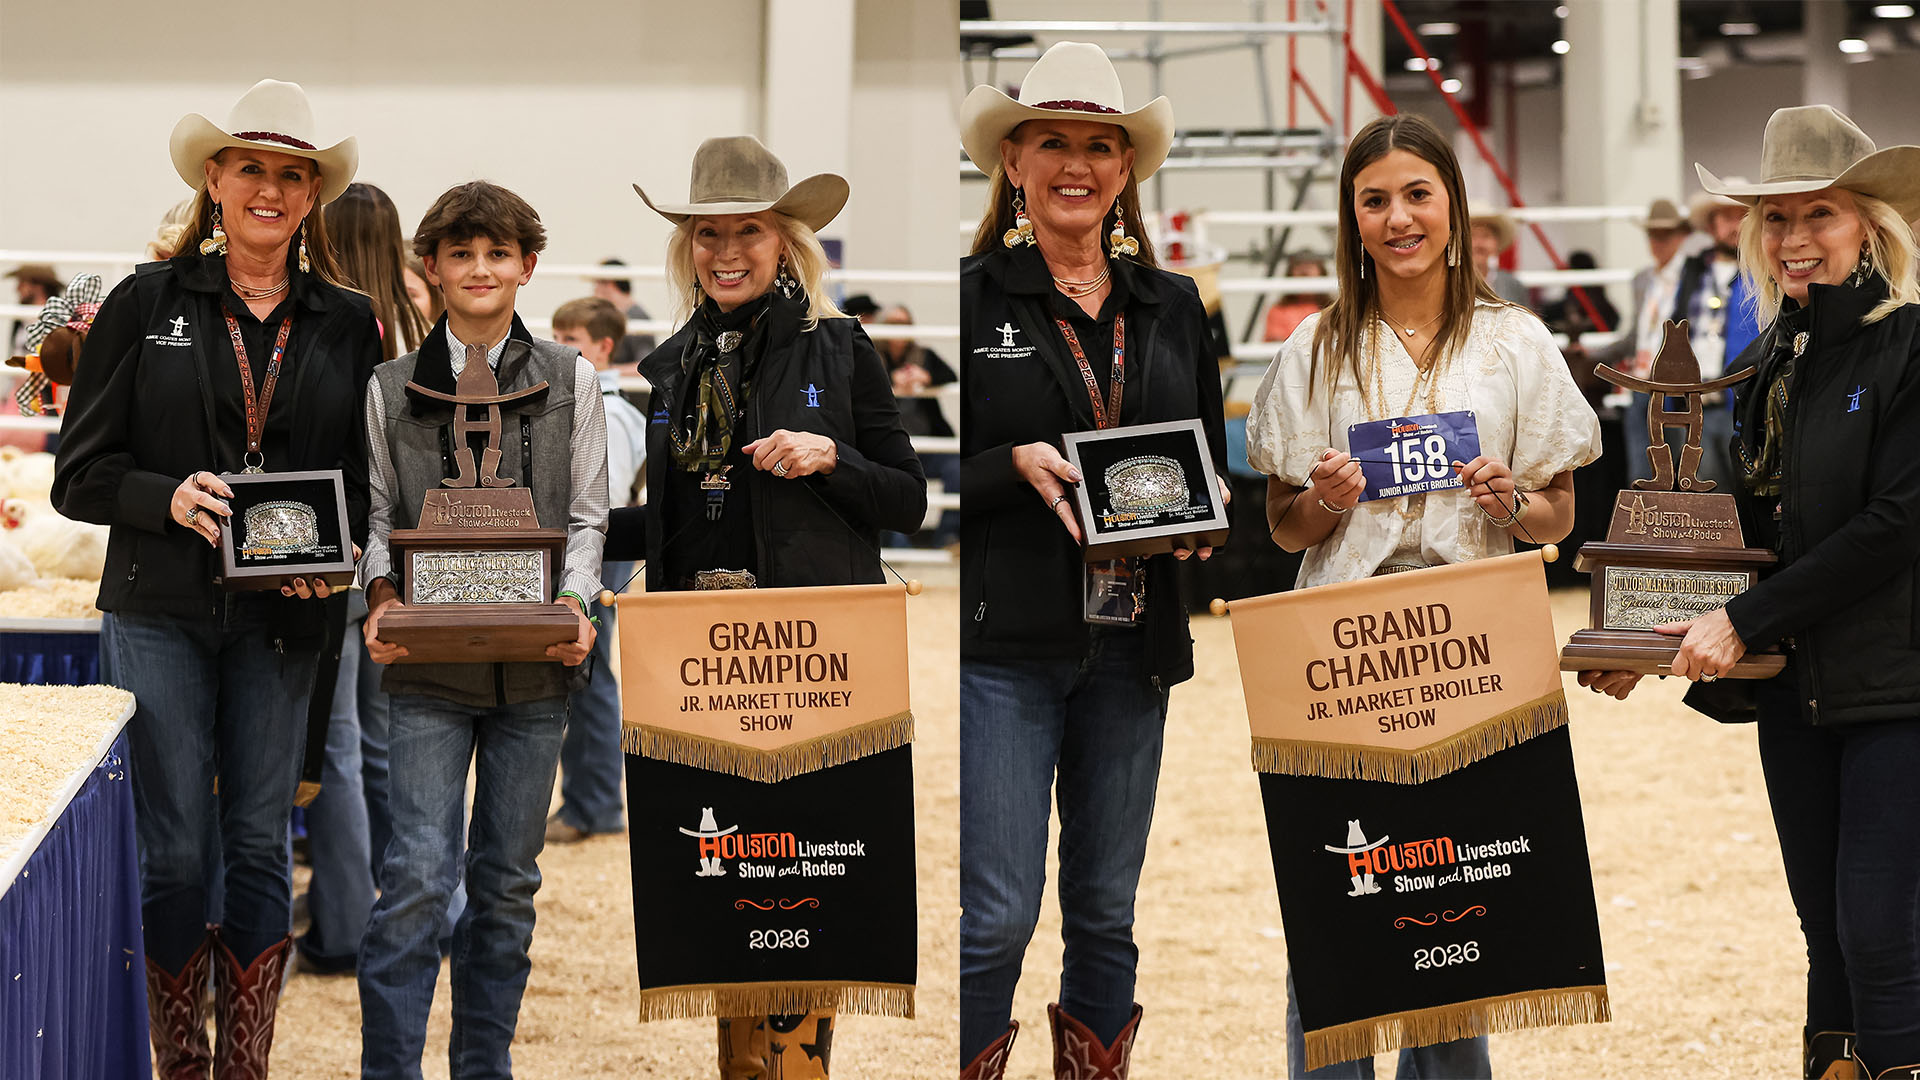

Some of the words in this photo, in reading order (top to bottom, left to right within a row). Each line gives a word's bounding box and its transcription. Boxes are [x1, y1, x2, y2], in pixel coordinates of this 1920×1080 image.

[1384, 435, 1449, 484] 158
[1379, 486, 1402, 498] JUNIOR
[1403, 482, 1430, 495] MARKET
[1431, 477, 1463, 490] BROILERS
[492, 507, 531, 517] Livestock
[458, 519, 480, 528] Show
[494, 518, 520, 527] Rodeo
[1653, 527, 1678, 539] Show
[1693, 530, 1721, 540] Rodeo
[1692, 518, 1734, 529] Livestock
[1614, 576, 1643, 591] JUNIOR
[1645, 578, 1678, 593] MARKET
[1680, 579, 1715, 594] BROILER
[1716, 580, 1741, 595] SHOW
[1620, 594, 1666, 610] Grand
[1667, 597, 1726, 614] Champio
[709, 620, 817, 651] GRAND
[1333, 603, 1452, 649] GRAND
[680, 653, 848, 686] CHAMPION
[1306, 633, 1491, 692] CHAMPION
[680, 696, 703, 712] JR.
[709, 693, 780, 711] MARKET
[784, 691, 852, 708] TURKEY
[1307, 702, 1332, 721] JR.
[1337, 687, 1414, 716] MARKET
[1420, 674, 1503, 703] BROILER
[740, 714, 793, 732] SHOW
[1378, 708, 1436, 733] SHOW
[799, 840, 865, 858] Livestock
[1457, 835, 1531, 862] Livestock
[738, 862, 775, 878] Show
[778, 860, 800, 878] and
[802, 860, 846, 877] Rodeo
[1394, 874, 1435, 893] Show
[1438, 866, 1462, 887] and
[1462, 862, 1511, 883] Rodeo
[749, 929, 810, 950] 2026
[1414, 941, 1481, 970] 2026
